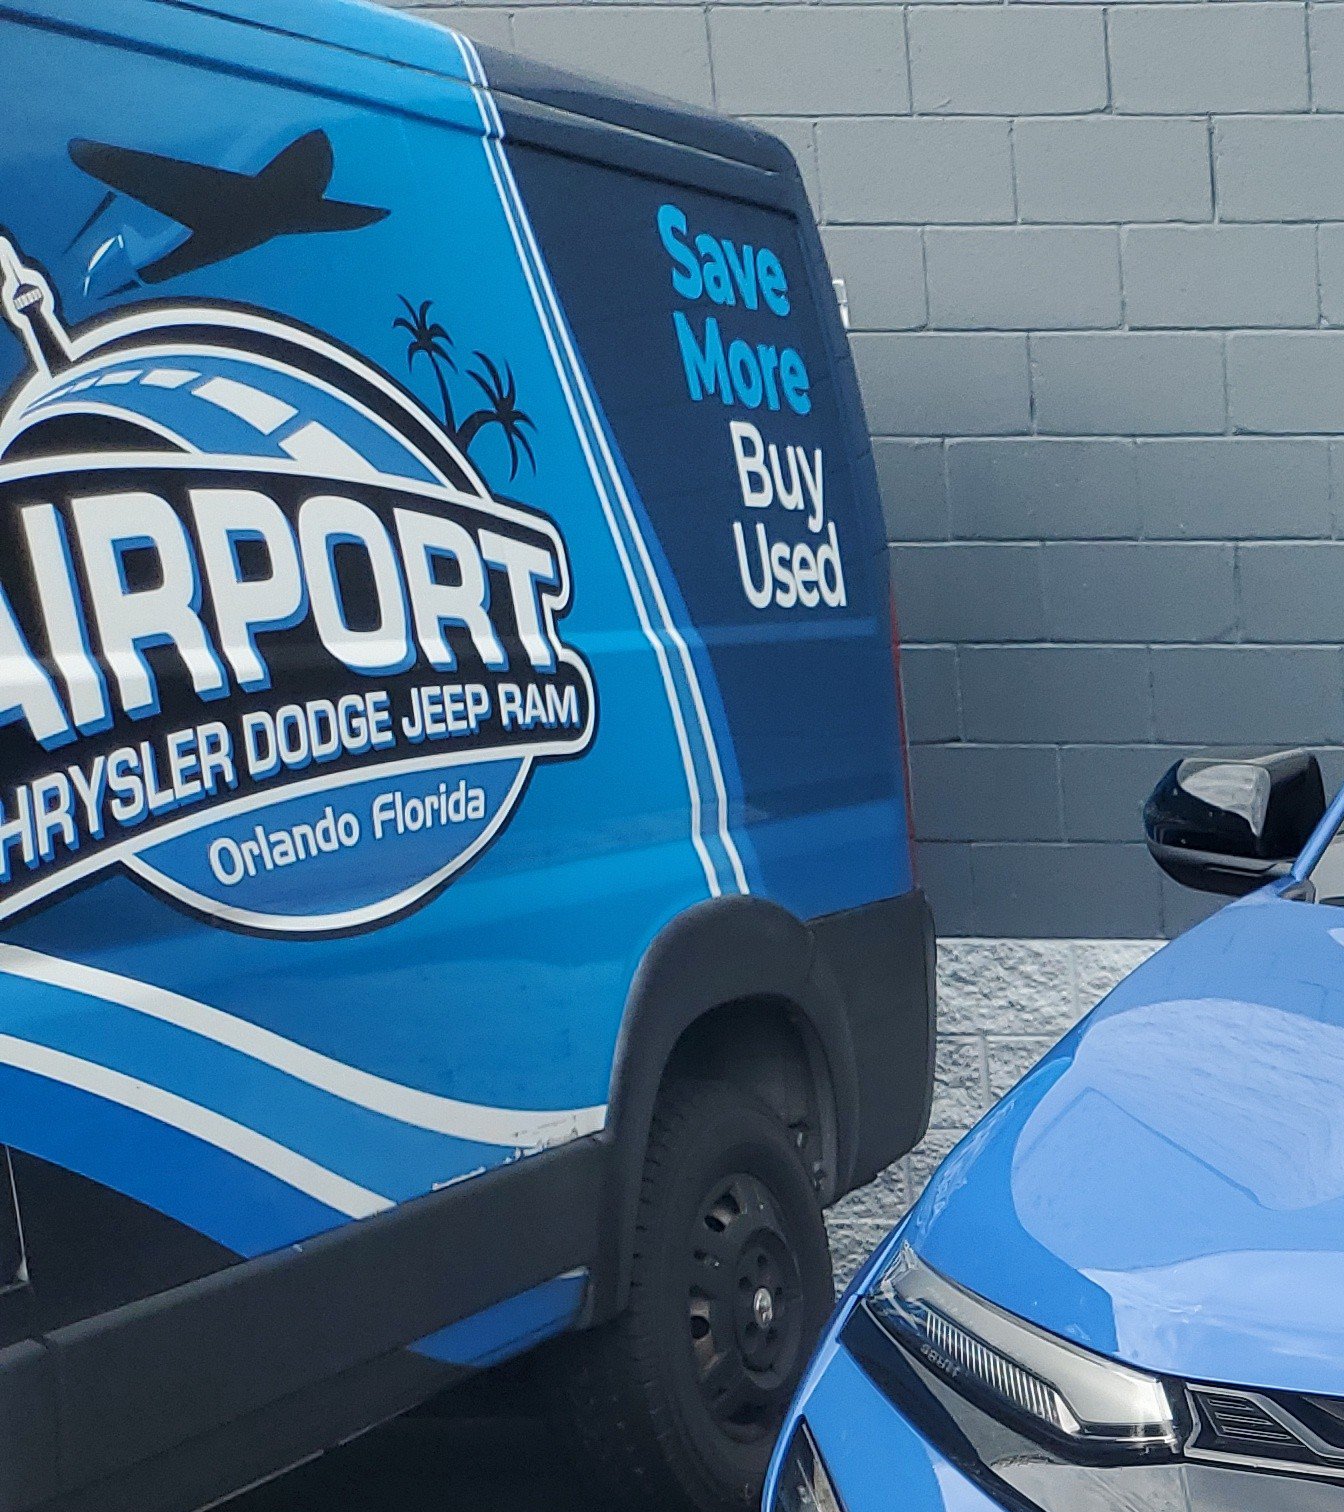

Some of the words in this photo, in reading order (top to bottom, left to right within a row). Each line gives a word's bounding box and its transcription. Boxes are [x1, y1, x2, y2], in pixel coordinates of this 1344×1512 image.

[657, 204, 791, 316] Save
[673, 310, 812, 414] More
[729, 420, 823, 533] Buy
[733, 521, 846, 609] Used
[0, 721, 236, 877] HRYSLER
[243, 689, 394, 780] DODGE
[401, 683, 492, 744] JEEP
[497, 682, 582, 730] RAM
[208, 806, 359, 886] Orlando
[372, 779, 486, 839] Florida
